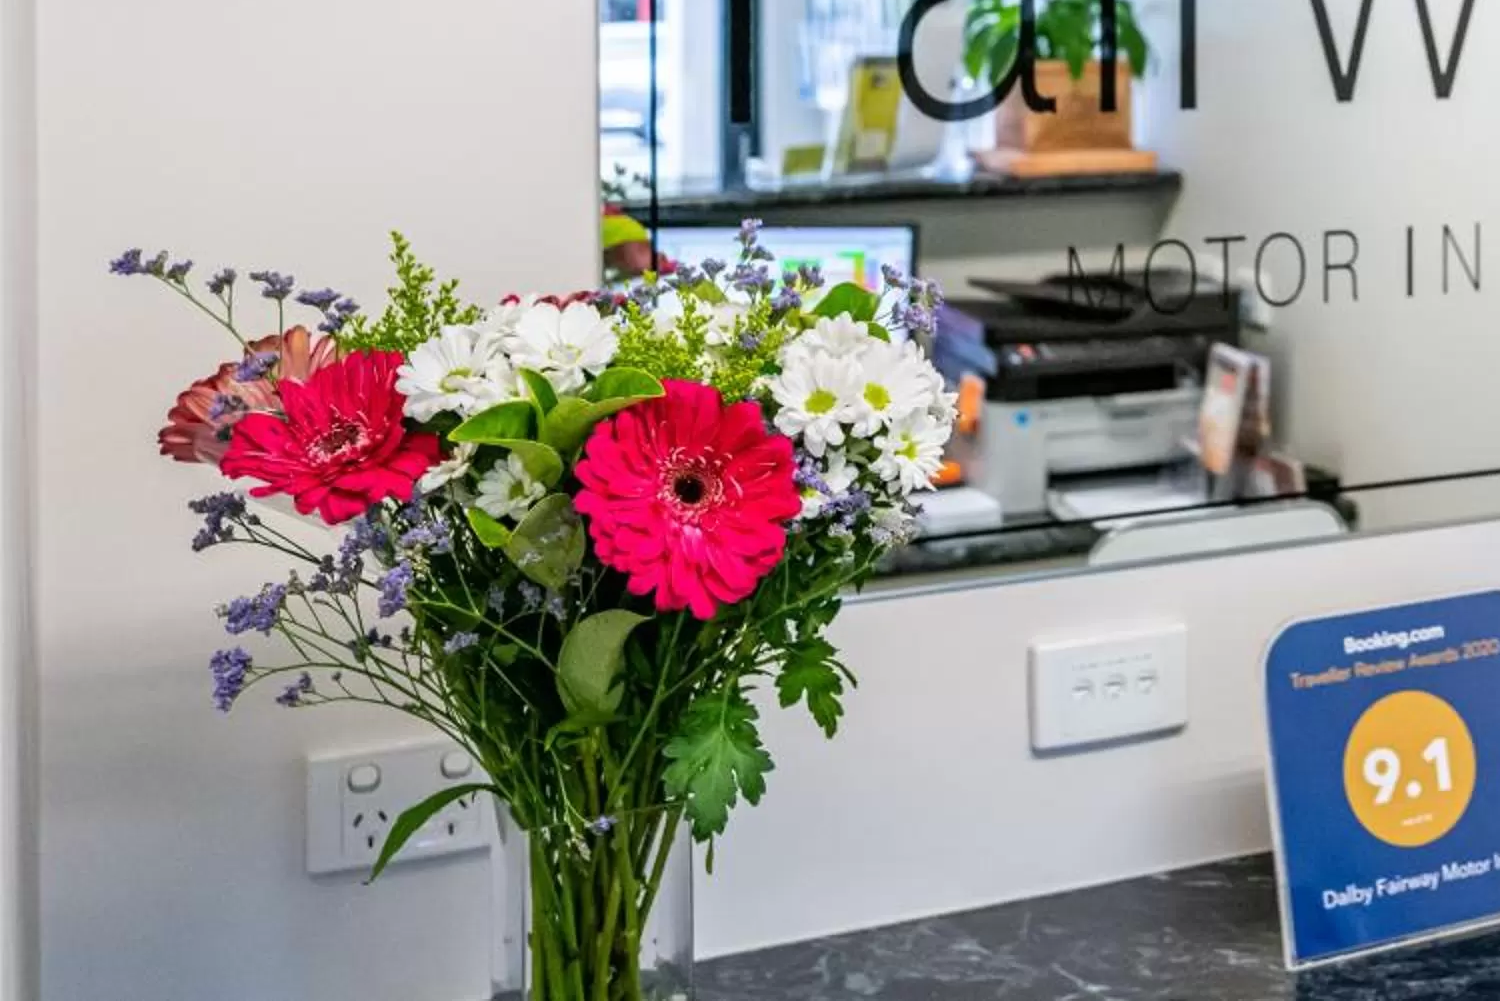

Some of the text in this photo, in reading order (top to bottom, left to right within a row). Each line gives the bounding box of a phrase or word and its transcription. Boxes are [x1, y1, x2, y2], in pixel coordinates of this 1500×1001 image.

[1066, 229, 1359, 316] MOTOR
[1343, 624, 1446, 655] Booking.com
[1353, 660, 1406, 678] Review
[1408, 647, 1460, 668] Awards
[1362, 736, 1454, 806] 9.1
[1322, 881, 1375, 910] Dalby
[1375, 870, 1441, 898] Fairway
[1441, 857, 1493, 882] Motor
